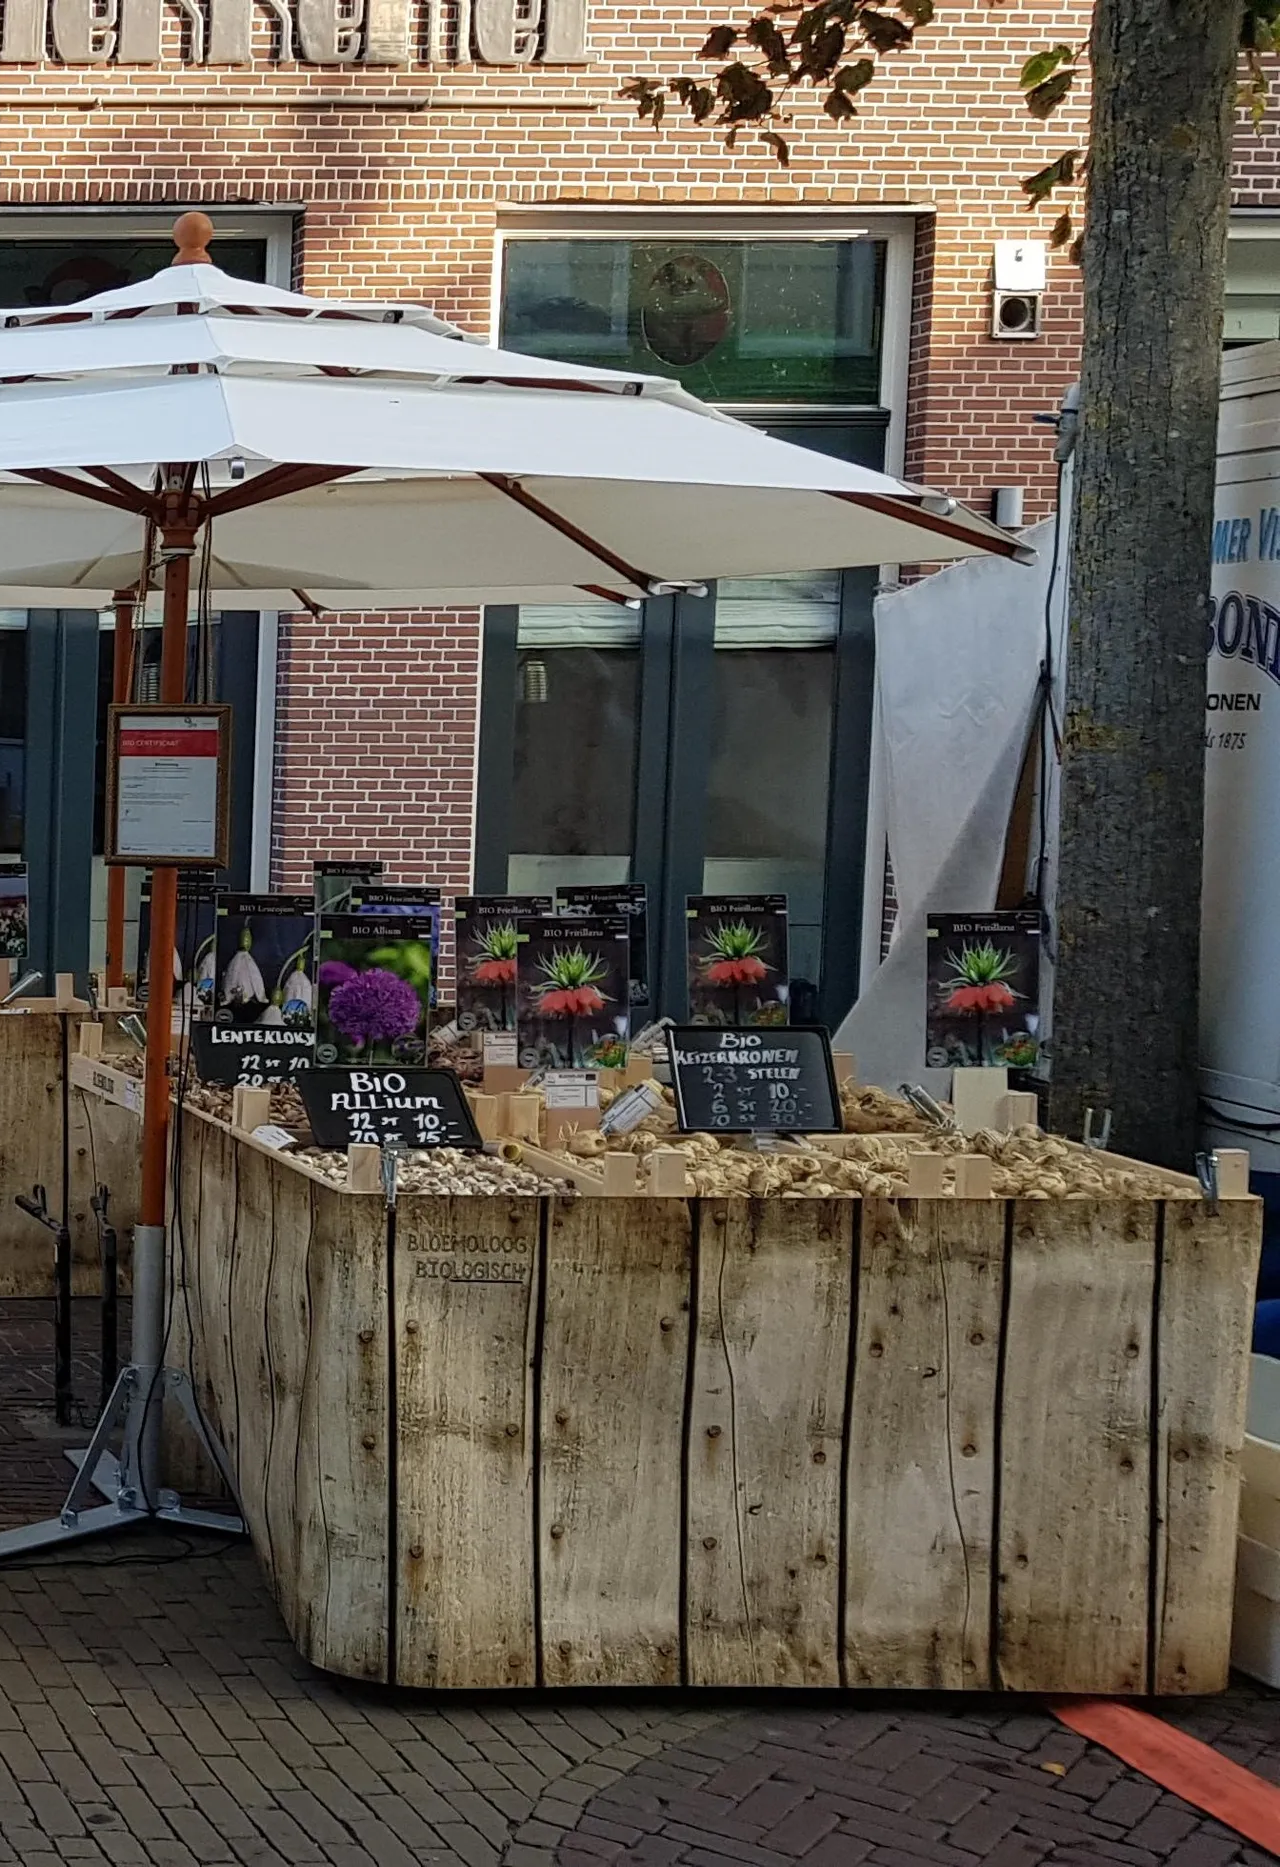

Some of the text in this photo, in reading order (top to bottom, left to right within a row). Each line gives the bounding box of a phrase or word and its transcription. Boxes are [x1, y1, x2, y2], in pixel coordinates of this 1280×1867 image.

[1213, 518, 1251, 564] MER
[1206, 692, 1261, 711] ONEN
[1218, 732, 1247, 750] 1875
[239, 904, 256, 912] BIO
[478, 906, 495, 914] BIO
[710, 905, 727, 913] BIO
[352, 926, 401, 935] BIO Allium
[543, 929, 562, 937] BIO
[953, 923, 972, 932] BIO
[241, 1054, 260, 1070] 12
[747, 1067, 801, 1080] STELEN
[711, 1099, 728, 1114] 6
[347, 1112, 376, 1130] 12
[415, 1260, 526, 1280] BIOLOGISCH
